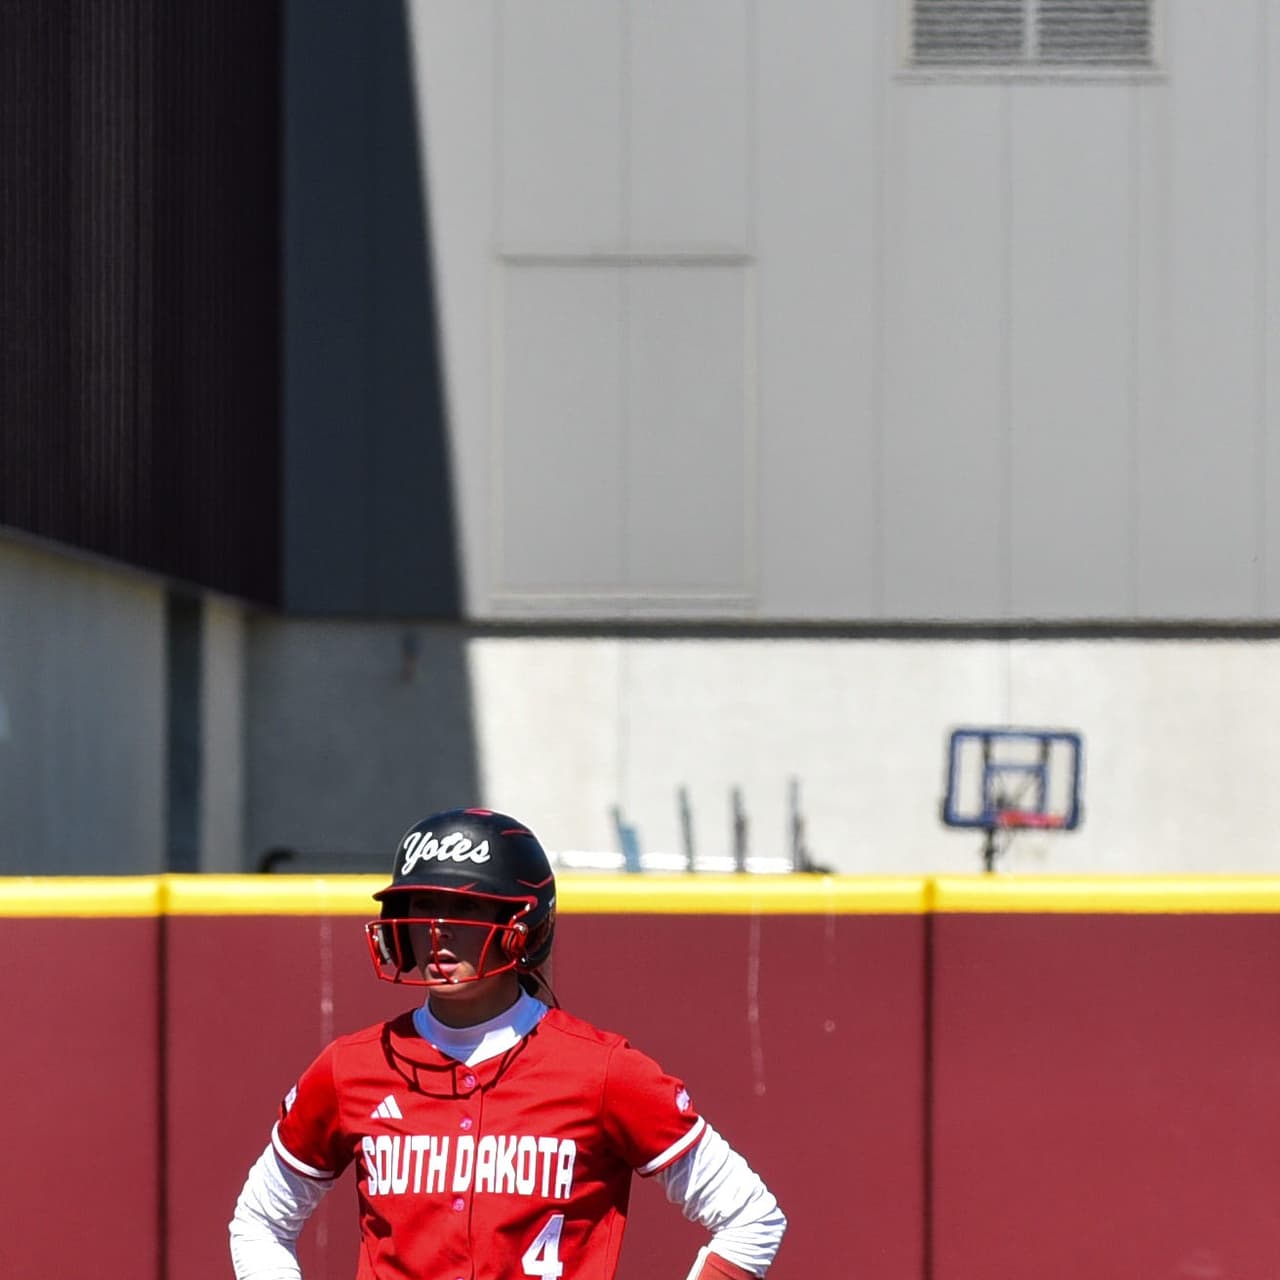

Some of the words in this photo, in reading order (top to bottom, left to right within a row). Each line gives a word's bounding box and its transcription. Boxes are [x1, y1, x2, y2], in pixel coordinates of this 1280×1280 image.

[400, 831, 491, 876] Yotes
[361, 1134, 450, 1196] SOUTH
[452, 1134, 577, 1200] DAKOTA
